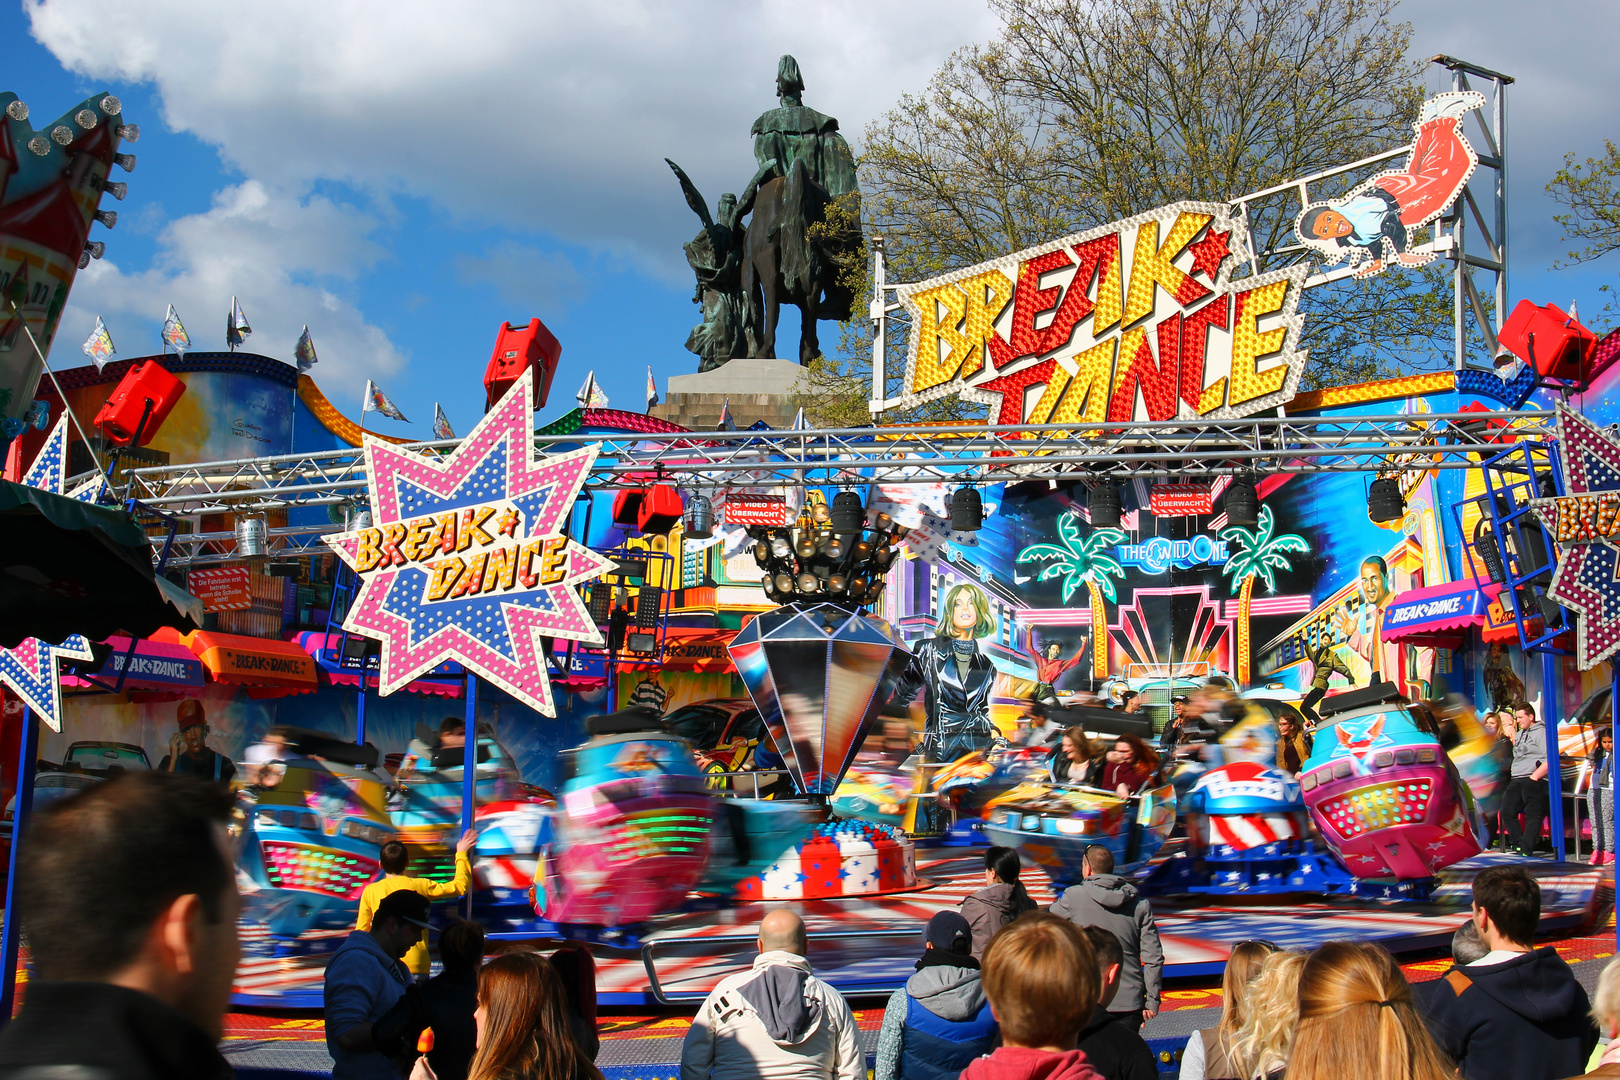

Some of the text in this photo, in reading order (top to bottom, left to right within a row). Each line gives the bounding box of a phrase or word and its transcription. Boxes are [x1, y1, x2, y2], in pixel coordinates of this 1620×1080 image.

[909, 211, 1214, 394] BREAK
[974, 279, 1289, 469] DANCE
[731, 509, 779, 518] ÜBERWACHT
[1557, 494, 1620, 541] BRE
[355, 506, 497, 573] BREAK
[1120, 545, 1147, 560] THE
[1192, 535, 1229, 562] ONE
[208, 577, 231, 585] Fahrbahn
[423, 536, 569, 602] DANCE
[235, 654, 300, 674] BREAK DANCE
[685, 645, 722, 658] DANCE
[113, 655, 186, 679] BRAK DANCE
